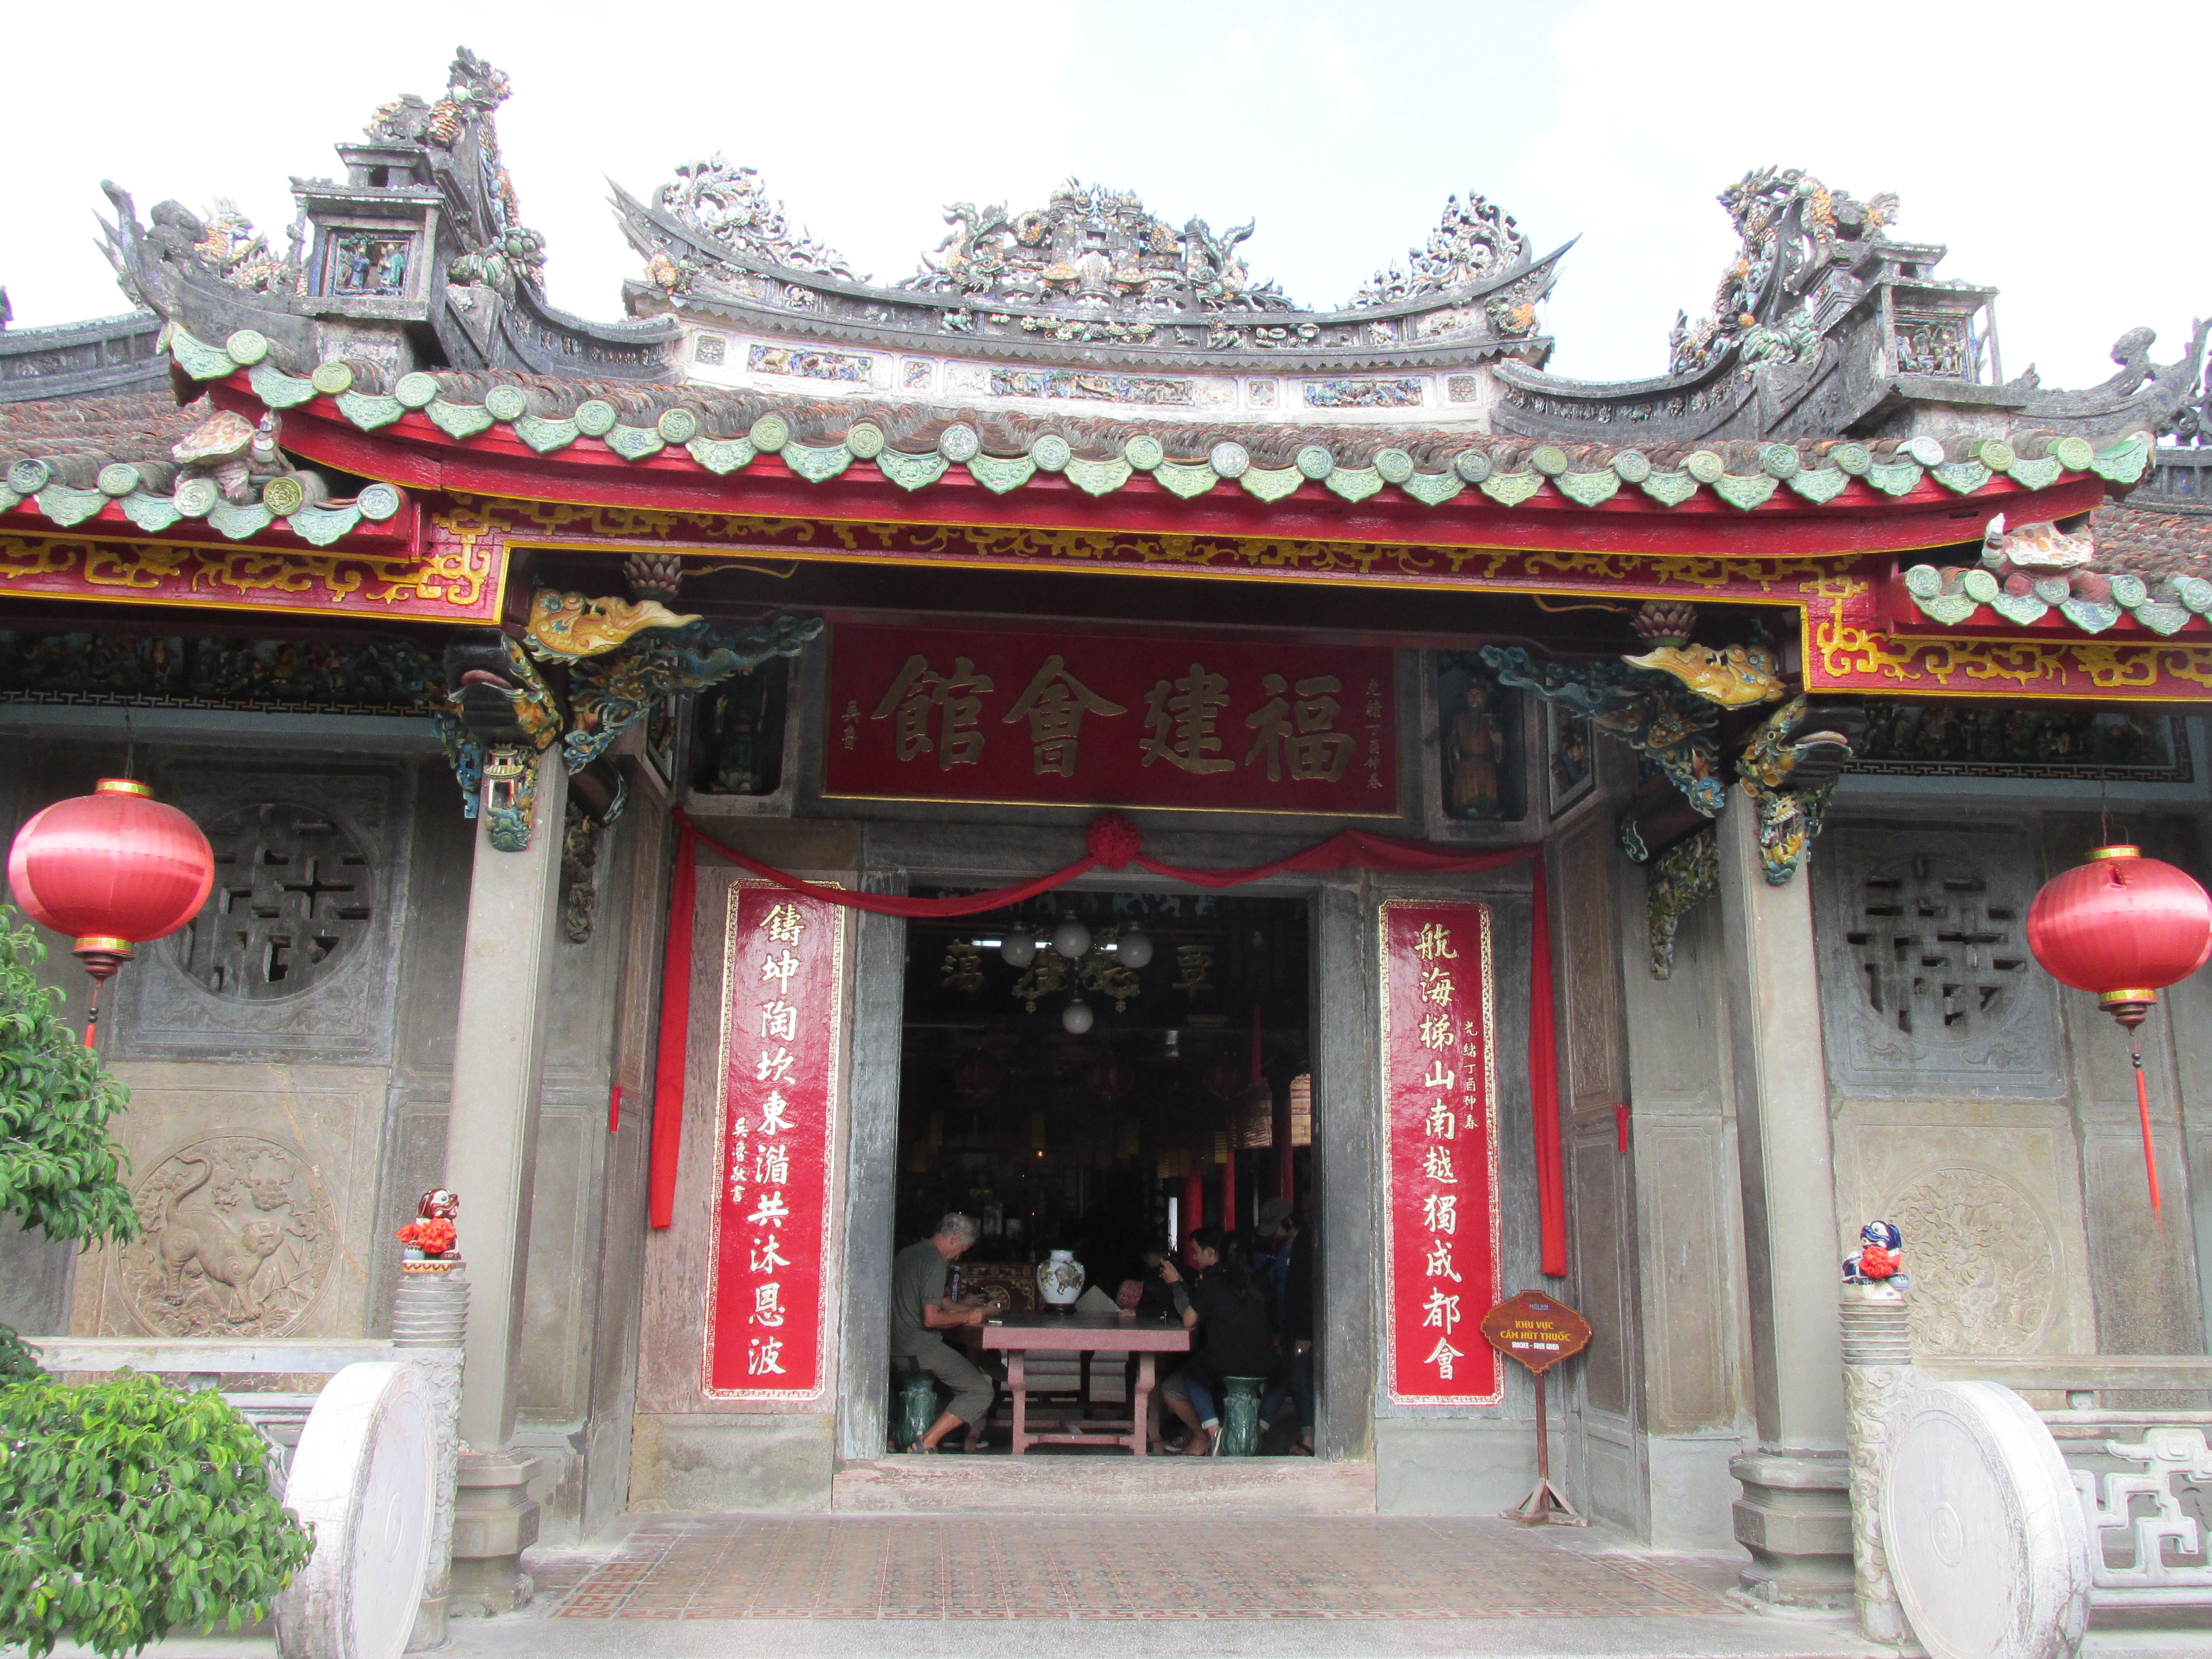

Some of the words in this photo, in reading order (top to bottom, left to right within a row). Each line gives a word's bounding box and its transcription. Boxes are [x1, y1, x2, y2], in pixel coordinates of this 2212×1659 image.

[871, 654, 1356, 782] 福建會館
[1463, 1020, 1479, 1130] 光緒丁酉仲春
[1414, 922, 1465, 1381] 航海梯山南越獨成都會
[1500, 1329, 1518, 1339] CẤM
[1521, 1331, 1539, 1340] HÚT
[1540, 1331, 1571, 1341] THUỐC
[1512, 1341, 1529, 1349] SMOKE
[1515, 1320, 1533, 1329] KHU
[1536, 1321, 1554, 1331] VỰC
